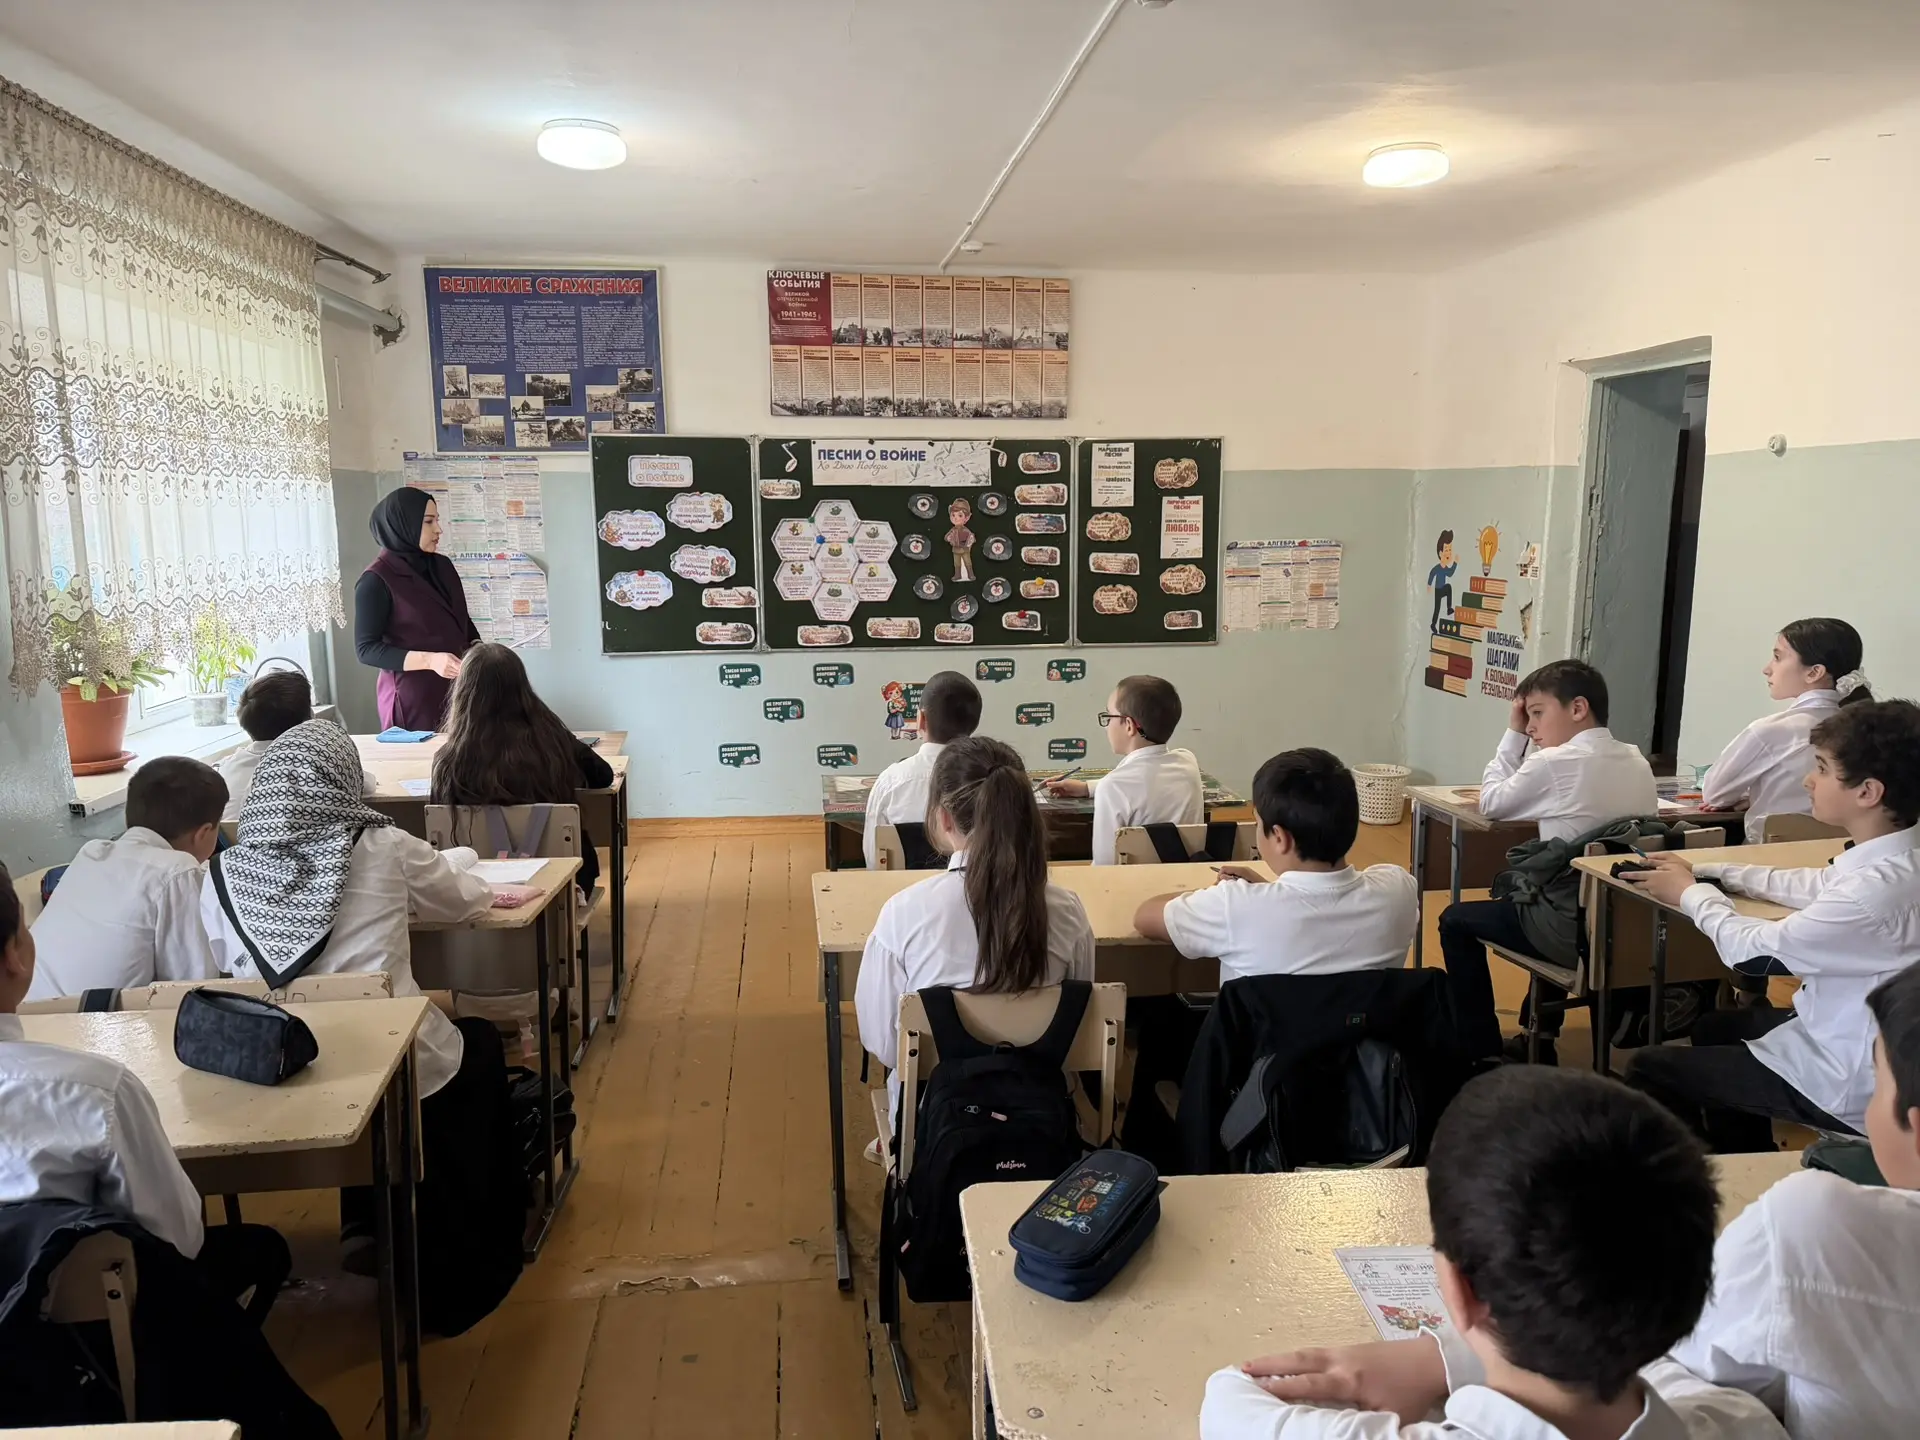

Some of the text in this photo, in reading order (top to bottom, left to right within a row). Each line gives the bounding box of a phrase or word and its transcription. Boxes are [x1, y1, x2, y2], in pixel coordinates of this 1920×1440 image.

[768, 270, 826, 280] КЛЮЧЕВЫЕ
[438, 276, 644, 296] ВЕЛИКИЕ СРАЖЕНИЯ
[773, 279, 821, 289] СОБЫТИЯ
[817, 447, 927, 462] ПЕСНИ О ВОЙНЕ
[640, 460, 680, 471] Песни
[832, 460, 854, 470] Дню
[856, 460, 889, 477] Победы
[646, 470, 685, 483] войне
[1165, 523, 1200, 532] ЛЮБОВЬ
[1486, 647, 1520, 672] ШАГАМИ
[1490, 668, 1518, 688] БОЛЬШИМ
